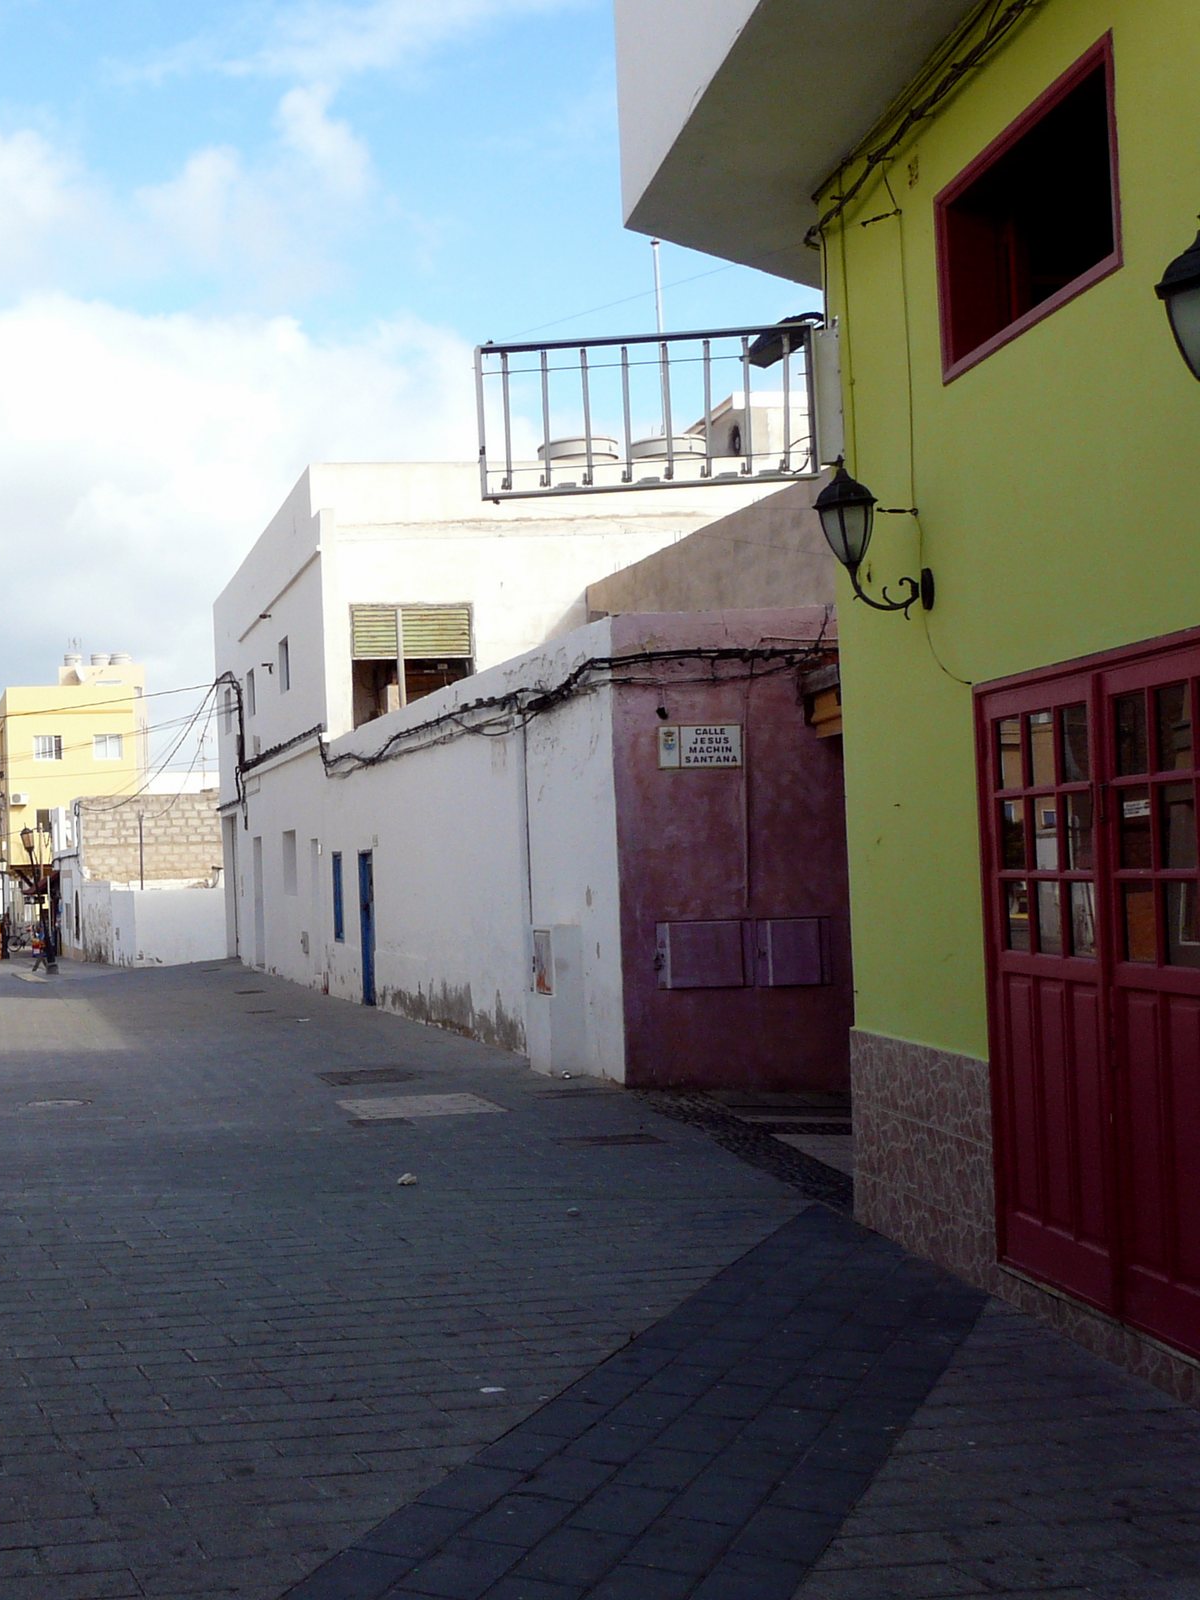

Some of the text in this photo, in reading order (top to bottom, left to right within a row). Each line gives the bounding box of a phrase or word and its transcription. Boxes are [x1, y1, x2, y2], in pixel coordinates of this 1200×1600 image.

[695, 727, 726, 736] CALLE
[692, 736, 730, 745] JESUS
[688, 745, 733, 754] MACHIN
[685, 755, 738, 764] SANTANA
